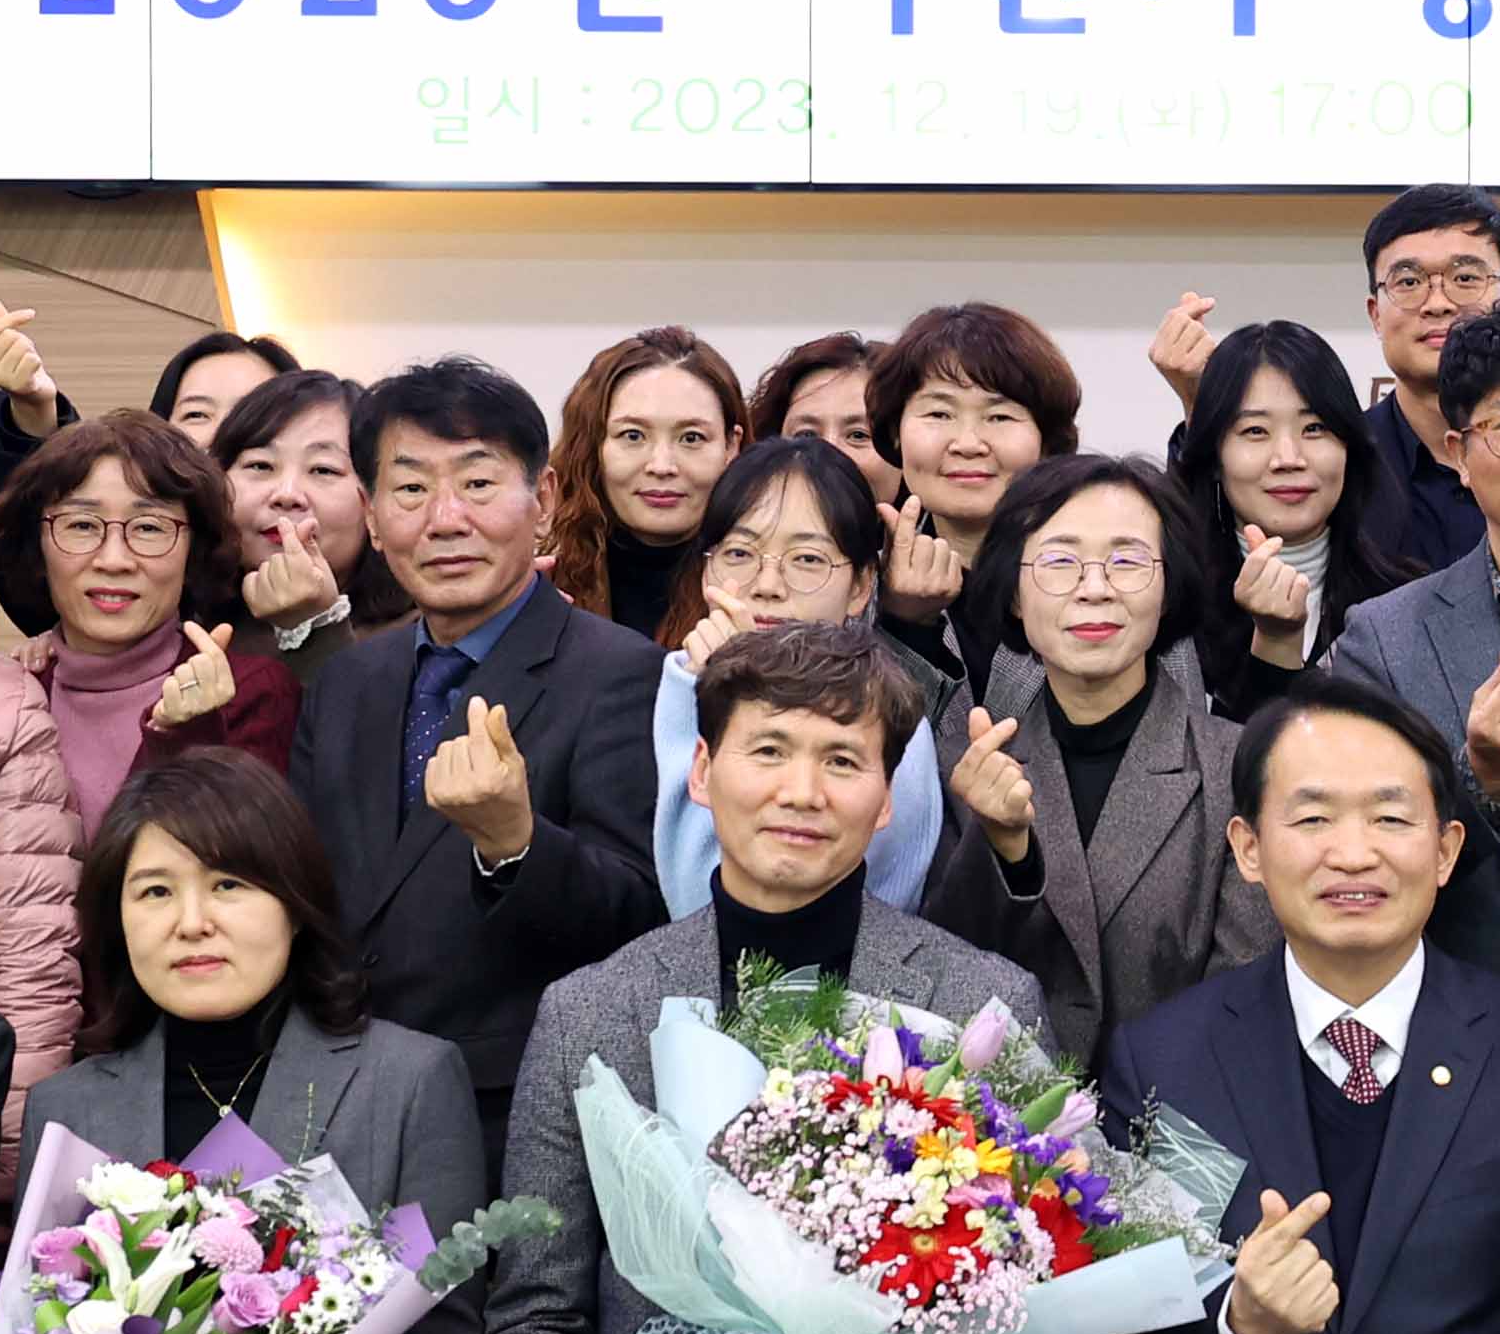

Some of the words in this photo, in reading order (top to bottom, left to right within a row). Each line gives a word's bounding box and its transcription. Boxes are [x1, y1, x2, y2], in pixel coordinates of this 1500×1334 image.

[415, 75, 541, 145] 일시
[629, 77, 838, 141] 2023.
[1268, 78, 1477, 138] 17:00
